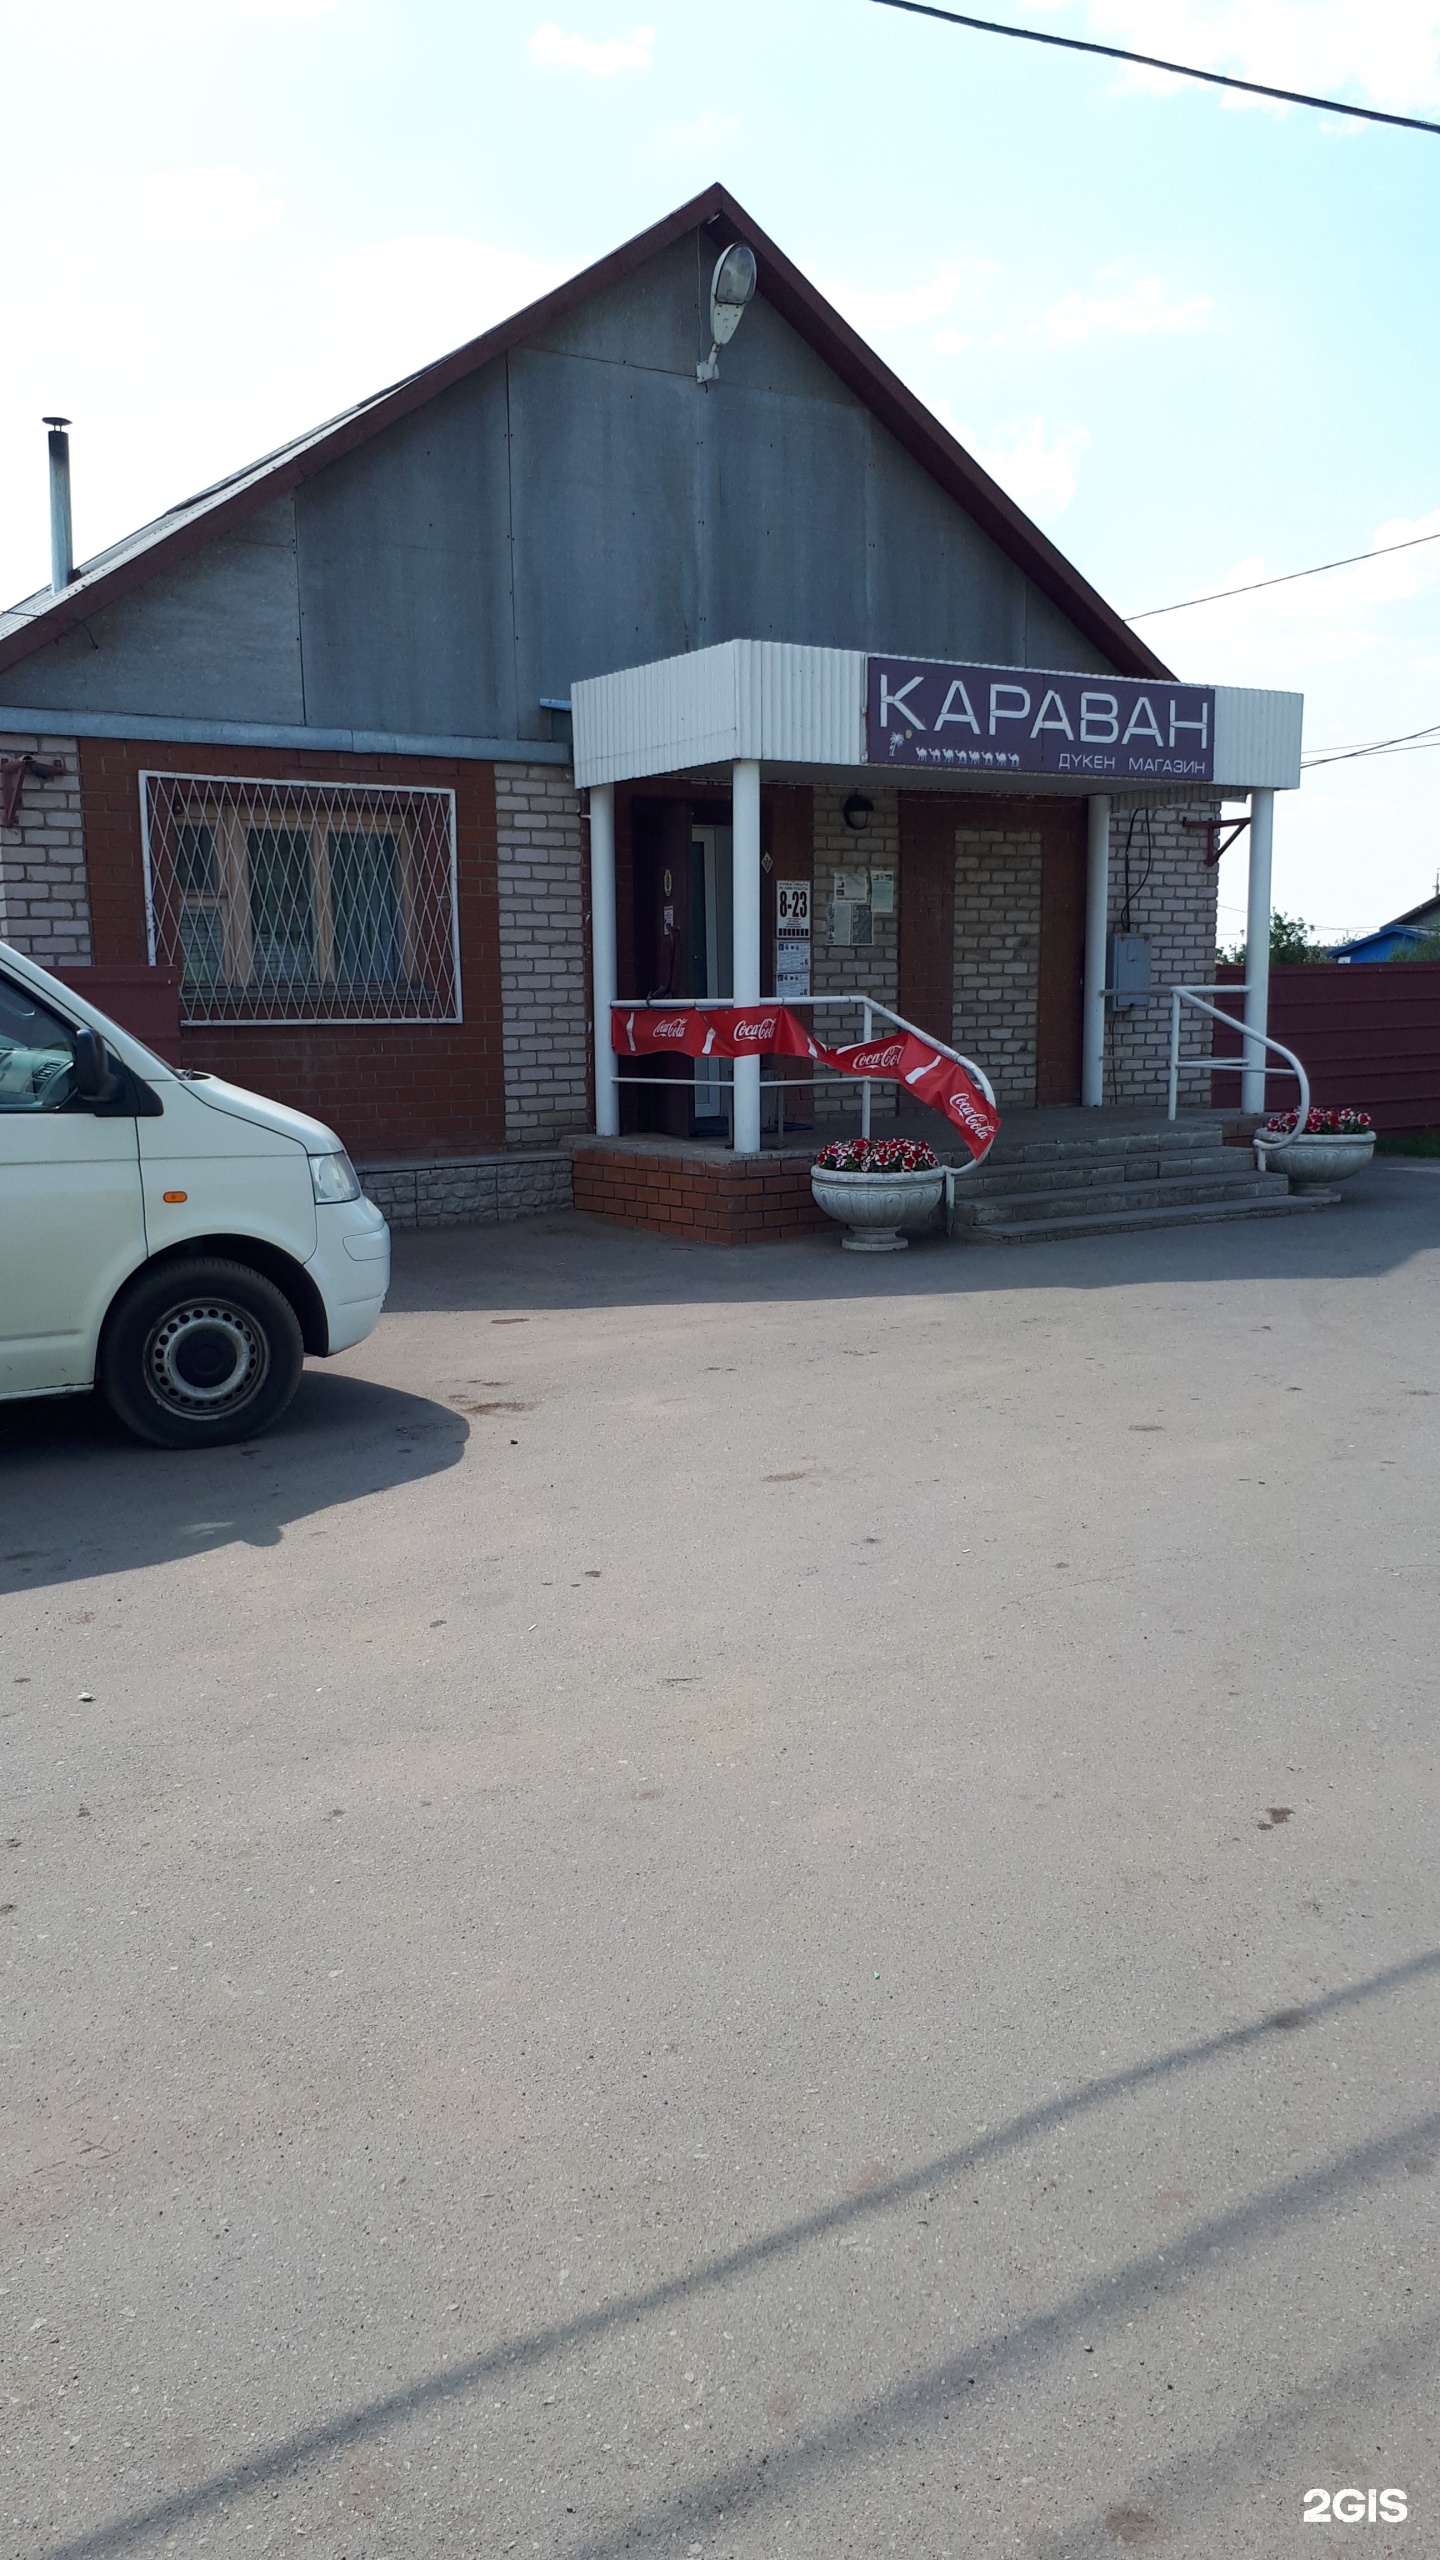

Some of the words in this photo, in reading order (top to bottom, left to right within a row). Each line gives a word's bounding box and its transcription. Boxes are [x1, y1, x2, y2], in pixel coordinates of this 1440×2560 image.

[880, 674, 1208, 749] КАРАВАН
[1128, 757, 1206, 774] МАГАЗИН
[779, 890, 808, 918] 8-23
[652, 1018, 689, 1038] Coca-Cola
[852, 1045, 905, 1070] Coca-Col
[949, 1093, 996, 1140] Coca-Cola
